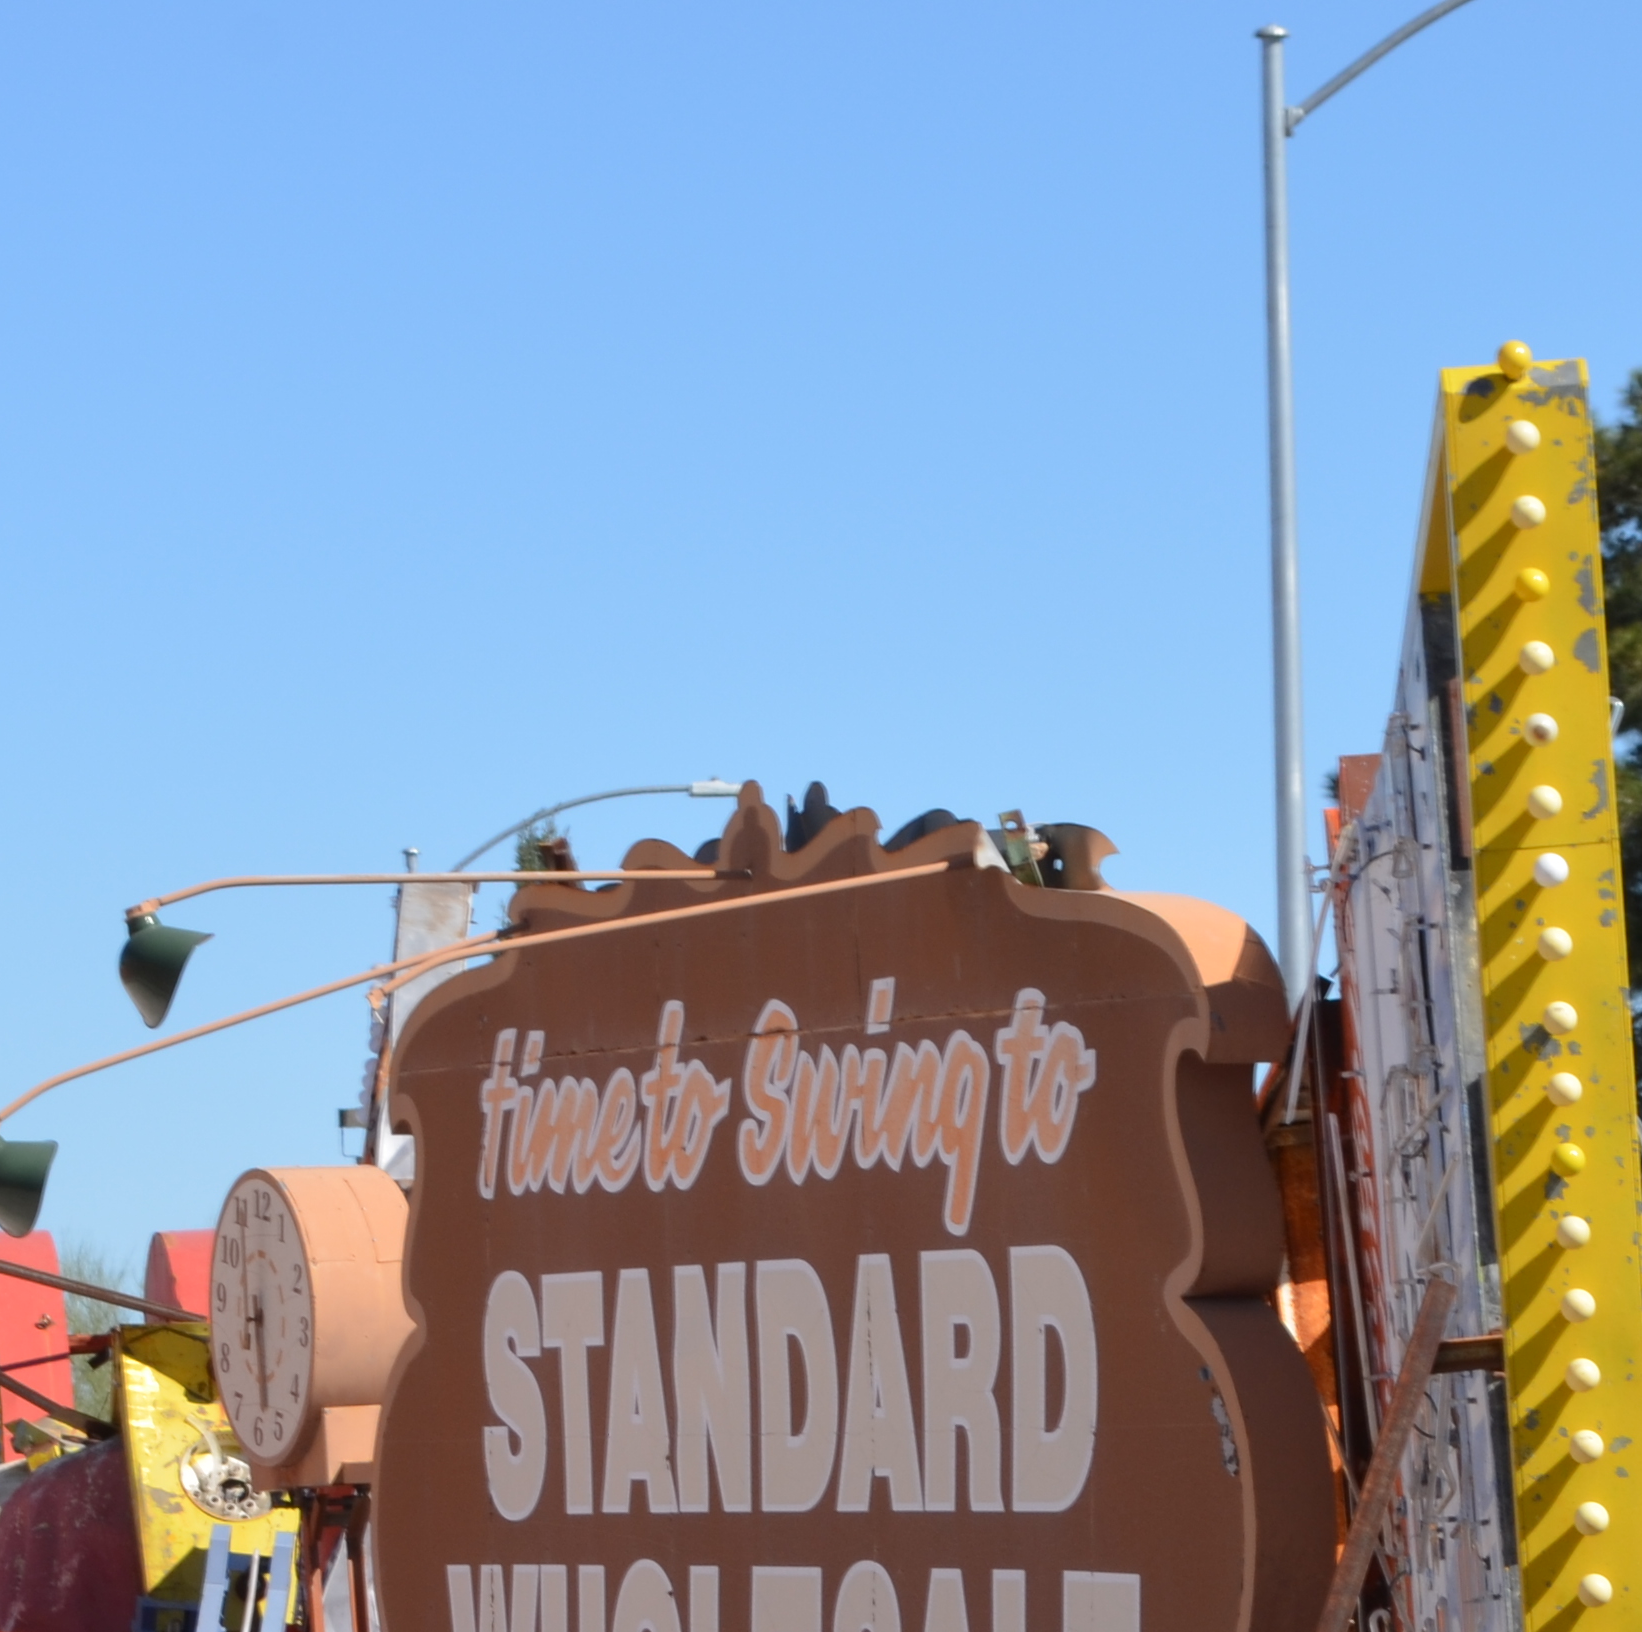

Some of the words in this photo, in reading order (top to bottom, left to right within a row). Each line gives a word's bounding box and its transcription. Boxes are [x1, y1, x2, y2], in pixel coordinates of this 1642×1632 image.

[643, 999, 733, 1194] to
[738, 976, 991, 1237] Swing
[994, 987, 1097, 1165] to
[253, 1189, 272, 1222] 12
[278, 1213, 287, 1244] 1
[221, 1235, 240, 1269] 10
[292, 1264, 303, 1295] 2
[217, 1282, 227, 1313] 9
[299, 1316, 309, 1348] 3
[220, 1343, 231, 1373] 8
[289, 1374, 300, 1404] 4
[482, 1244, 1100, 1522] STANDARD
[233, 1392, 244, 1421] 7
[253, 1416, 264, 1446] 6
[273, 1412, 285, 1441] 5
